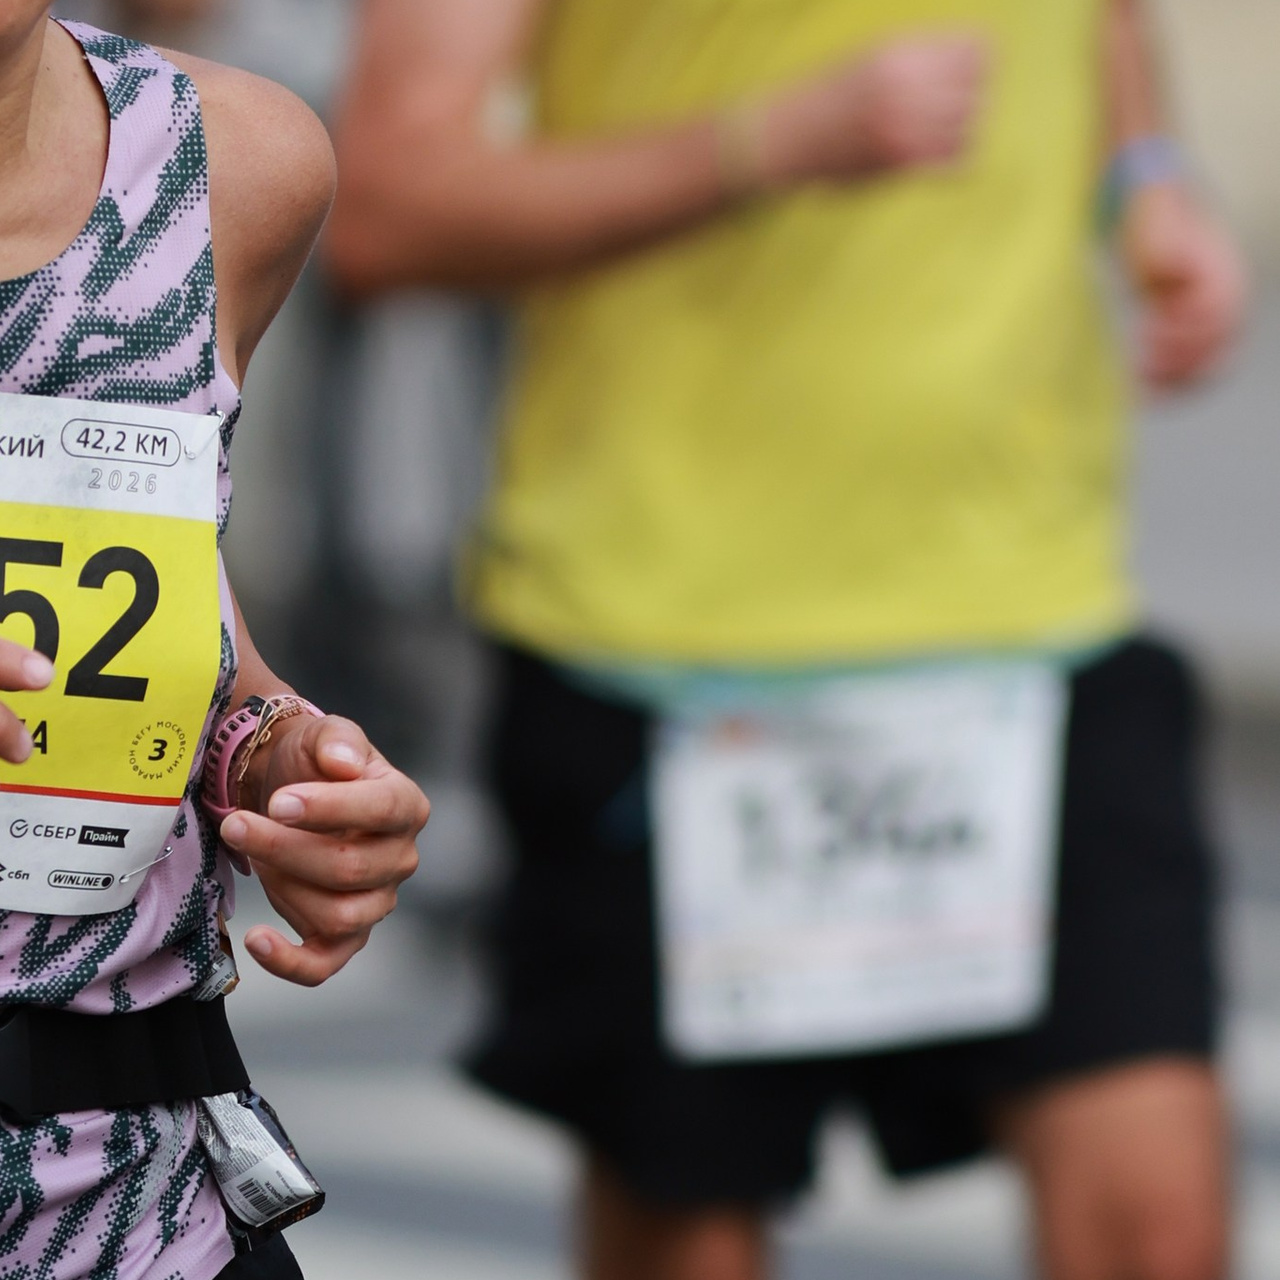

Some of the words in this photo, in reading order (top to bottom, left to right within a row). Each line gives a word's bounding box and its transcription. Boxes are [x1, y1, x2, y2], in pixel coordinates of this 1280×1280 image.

[76, 427, 127, 454] 42,2
[135, 433, 168, 457] КМ
[87, 468, 157, 494] 2026
[147, 738, 168, 762] 3
[32, 824, 77, 840] СБЕР
[83, 830, 120, 843] Прайм
[53, 873, 102, 887] WINLINE
